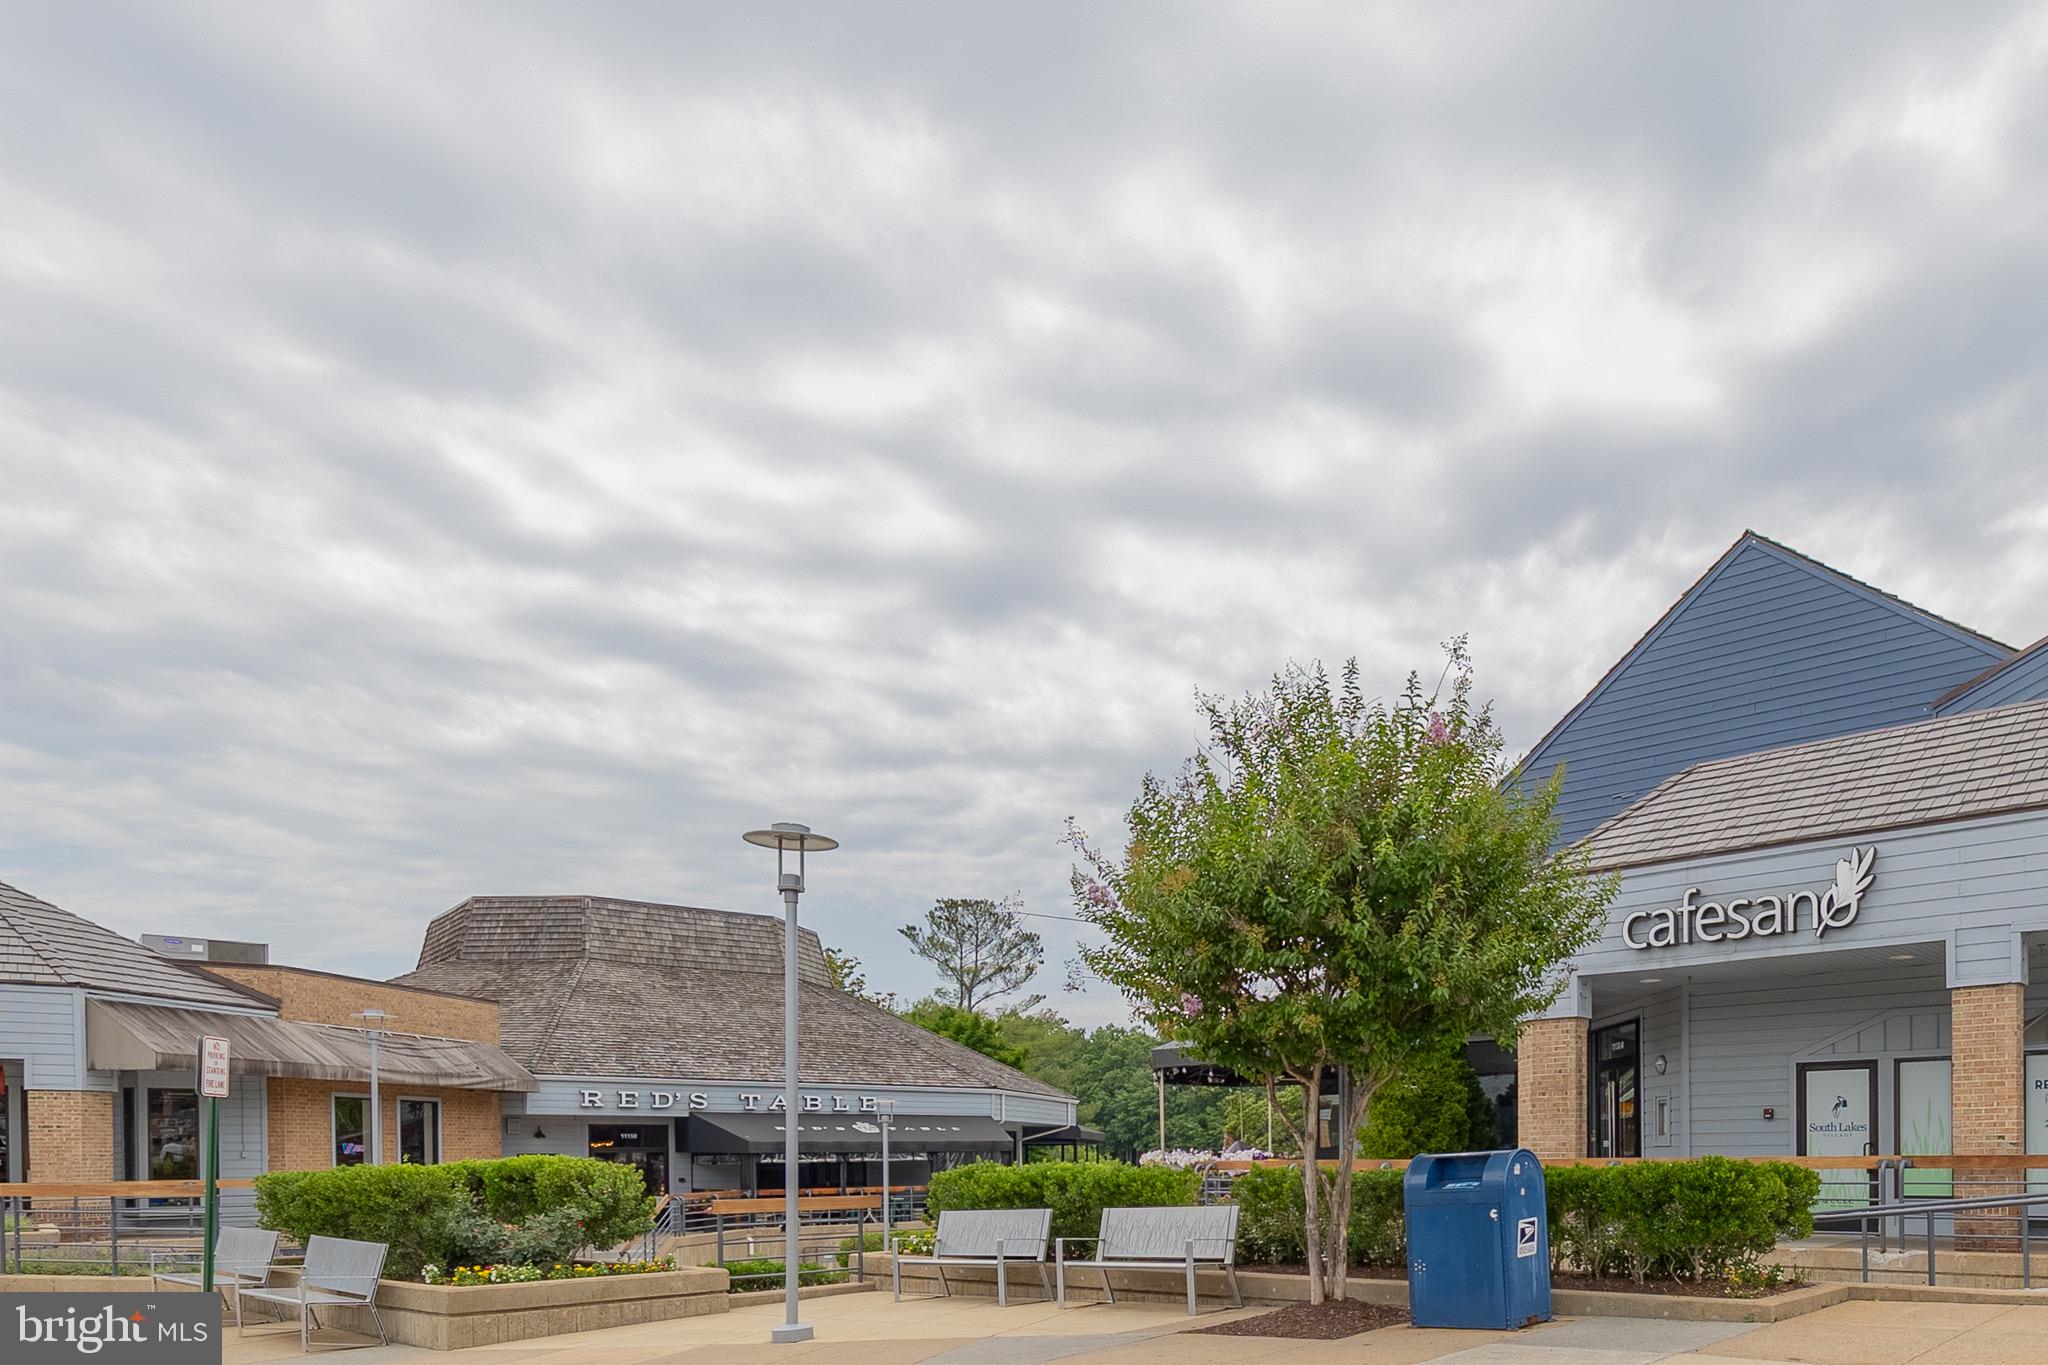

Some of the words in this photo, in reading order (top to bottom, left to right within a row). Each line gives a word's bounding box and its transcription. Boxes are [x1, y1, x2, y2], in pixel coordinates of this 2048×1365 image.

[1622, 884, 1861, 950] cafesano
[207, 1051, 225, 1060] PARKING
[580, 1090, 709, 1110] RED'S
[740, 1094, 878, 1112] TABLE
[1809, 1122, 1837, 1132] South
[1839, 1122, 1867, 1132] Lakes
